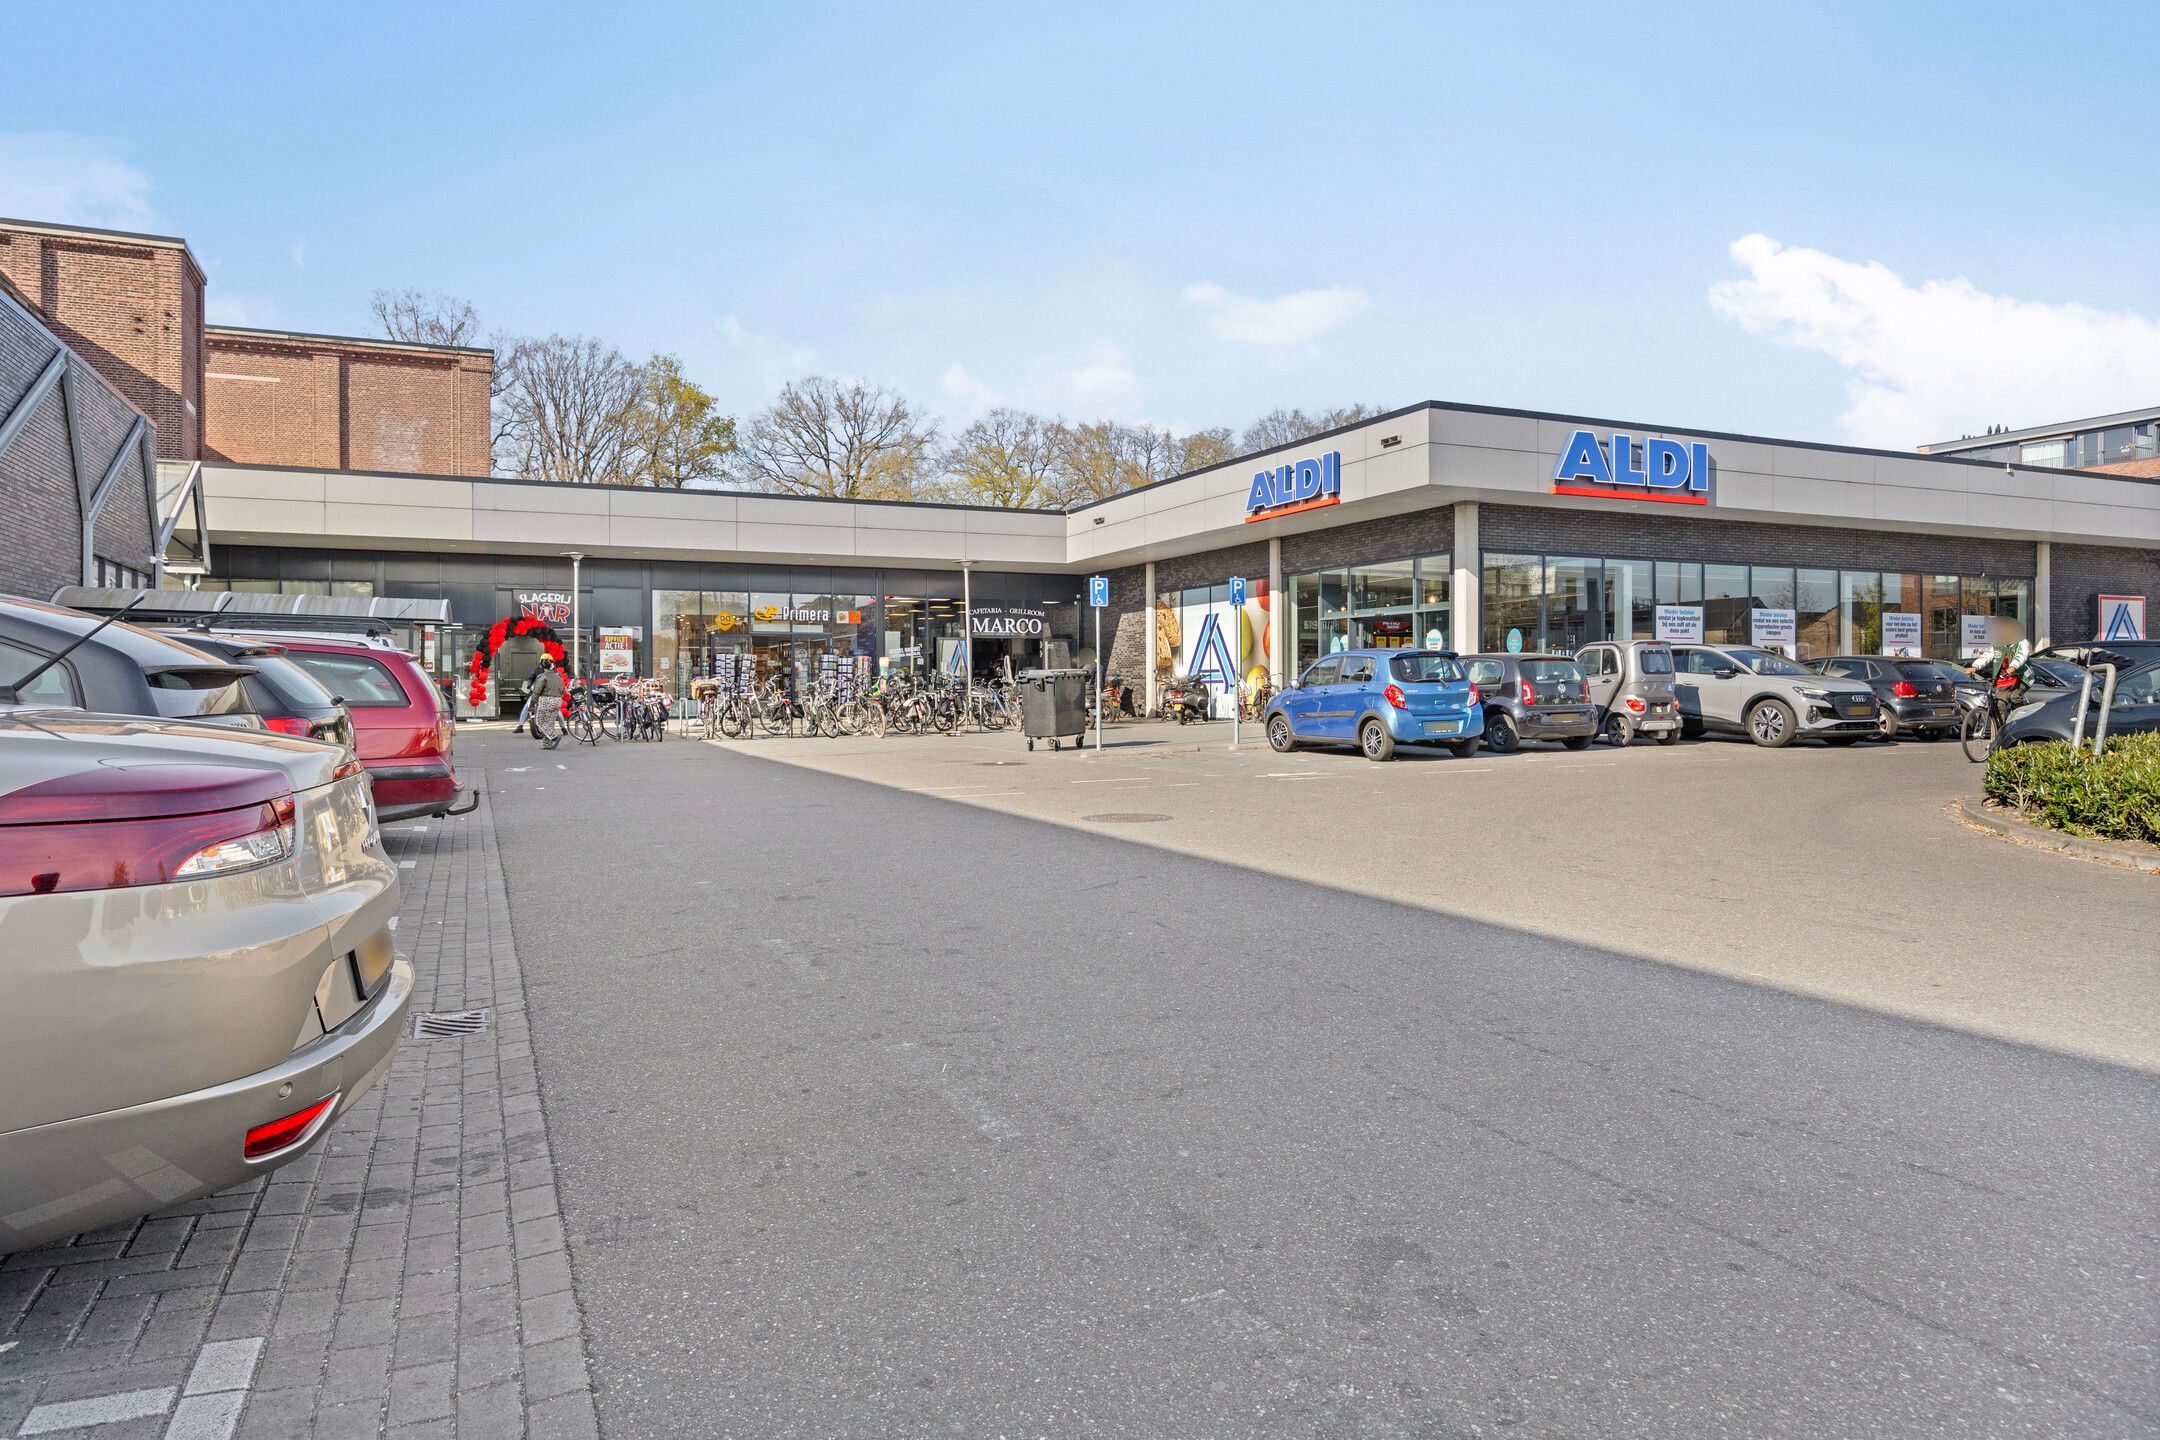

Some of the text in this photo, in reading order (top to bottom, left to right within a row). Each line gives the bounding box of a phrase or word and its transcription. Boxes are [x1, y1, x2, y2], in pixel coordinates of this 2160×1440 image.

[1552, 430, 1708, 491] ALDI
[1246, 451, 1340, 512] ALDI
[1094, 581, 1104, 595] P
[1233, 581, 1243, 594] P
[519, 592, 571, 604] SLAGERIJ
[520, 603, 571, 624] NAR
[783, 606, 829, 621] Primera
[969, 607, 1002, 616] CAFETARIA
[1009, 607, 1045, 617] GRILLROOM
[972, 617, 1042, 634] MARCO
[604, 635, 628, 643] KIPFILET
